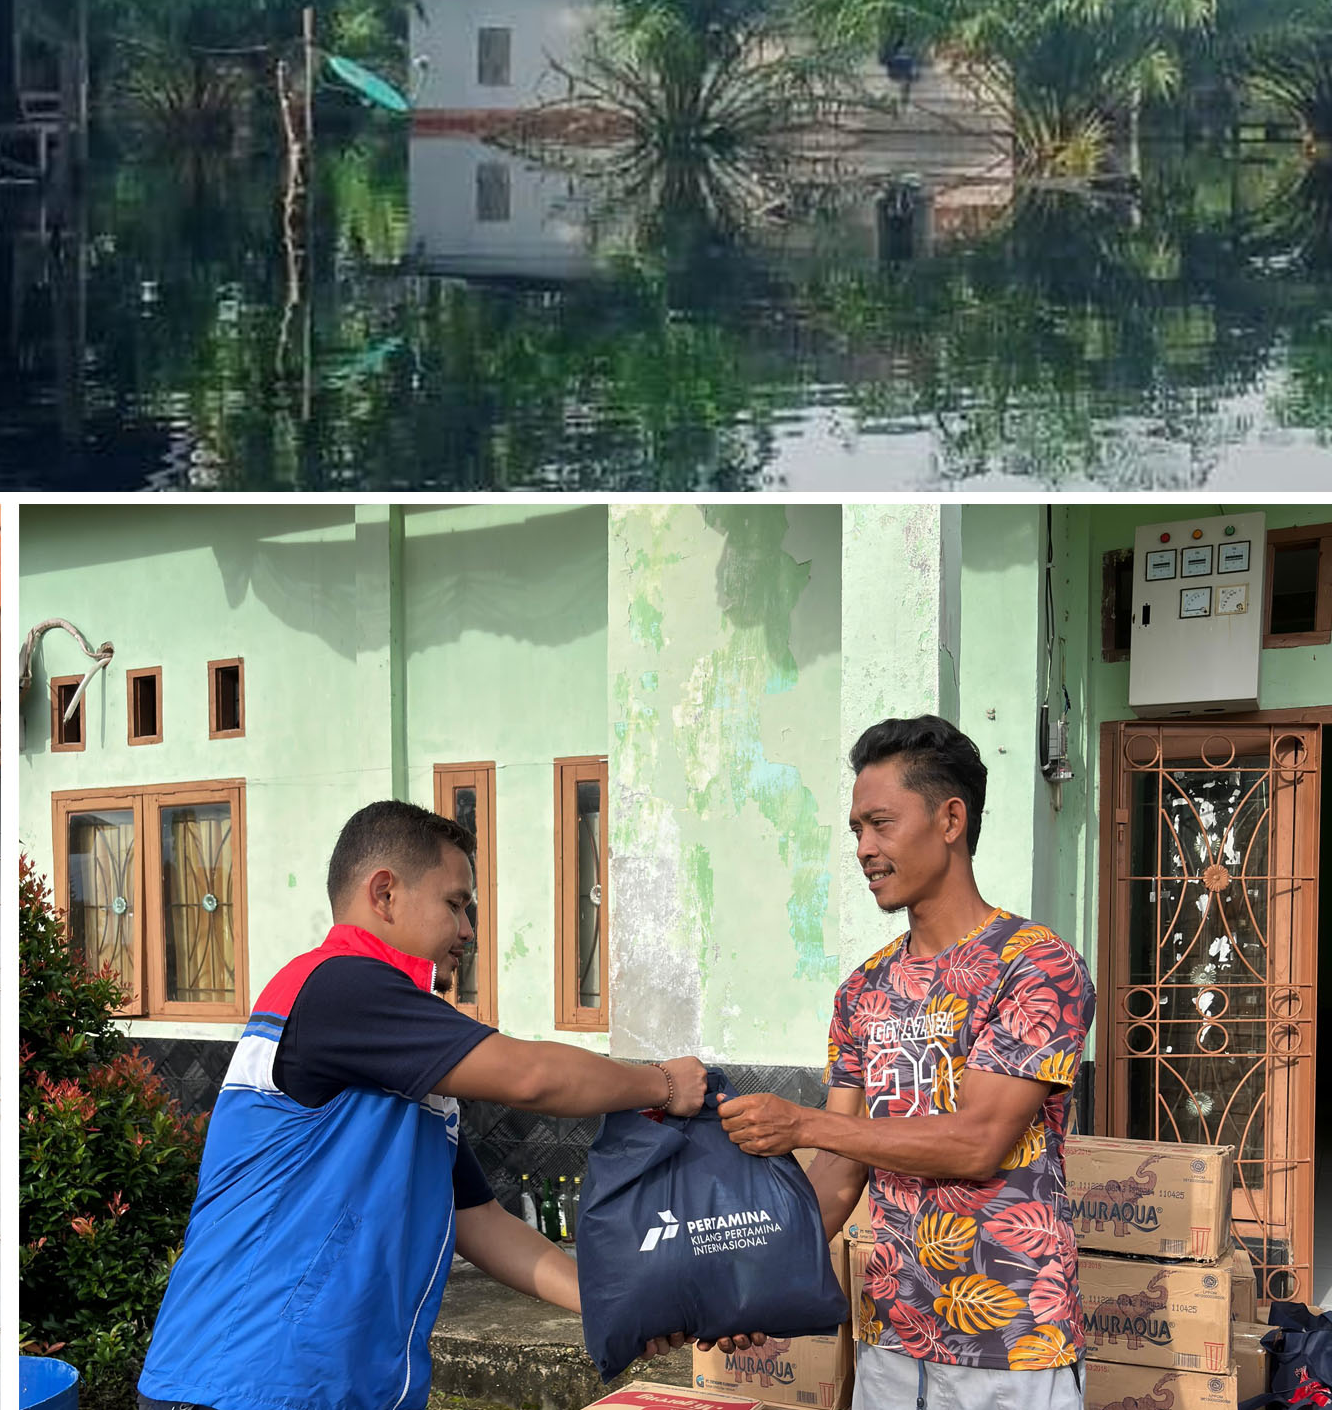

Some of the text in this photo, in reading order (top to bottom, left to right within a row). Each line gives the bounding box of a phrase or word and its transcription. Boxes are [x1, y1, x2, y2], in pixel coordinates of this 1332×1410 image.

[1158, 1190, 1185, 1200] 110425
[686, 1209, 772, 1234] PERTAMINA
[690, 1222, 782, 1246] KILANG PERTAMINA
[693, 1235, 768, 1256] INTERNASIONAL
[1171, 1303, 1198, 1314] 110425
